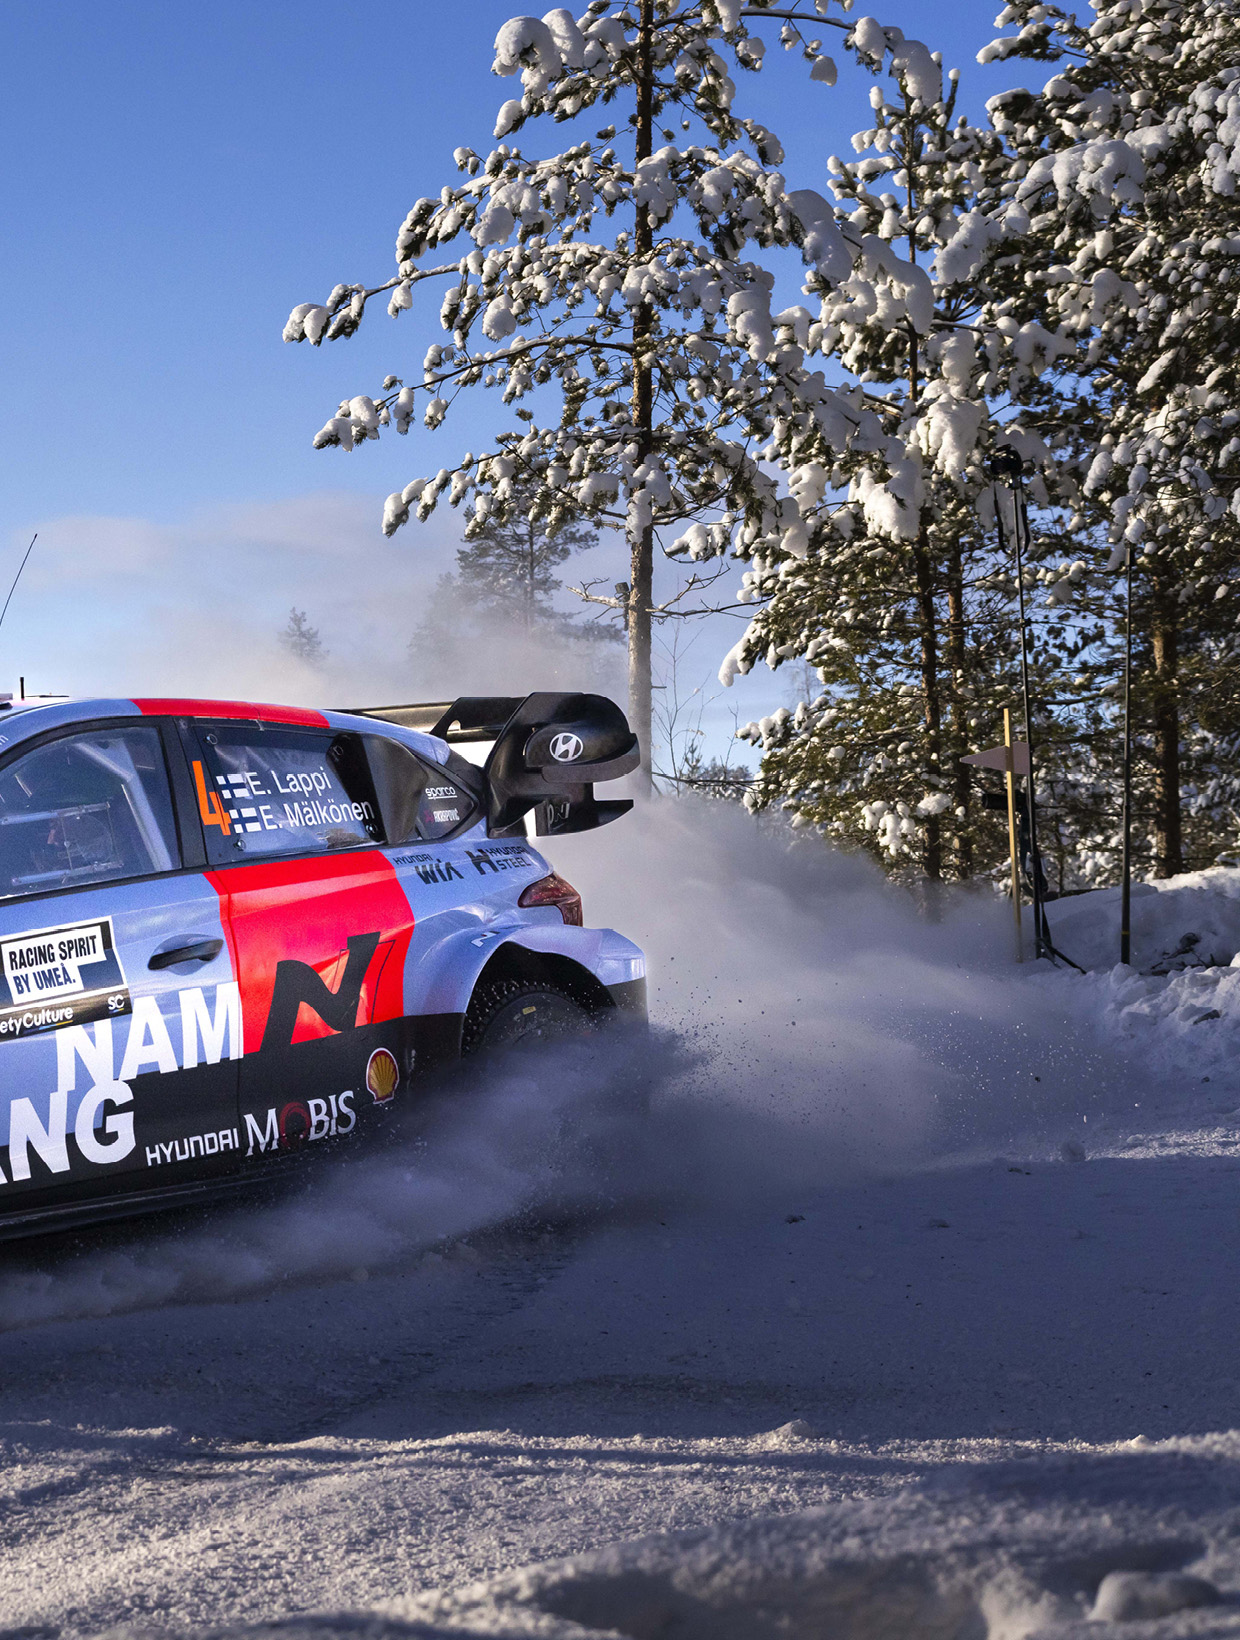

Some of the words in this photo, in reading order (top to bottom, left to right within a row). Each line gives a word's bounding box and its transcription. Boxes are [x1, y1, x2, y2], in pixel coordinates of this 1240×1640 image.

[192, 760, 231, 836] 4
[245, 771, 271, 795] E.
[271, 766, 332, 798] Lappi
[425, 786, 457, 800] sparco
[260, 804, 282, 831] E.
[283, 799, 375, 828] Mälkönen
[393, 853, 434, 865] HYUNDAI
[485, 846, 527, 857] HYUNDAI
[497, 856, 531, 870] STEEL
[8, 947, 55, 971] RACING
[58, 935, 98, 962] SPIRIT
[13, 973, 31, 995] BY
[35, 963, 76, 991] UMEÅ.
[107, 994, 125, 1012] SC
[55, 981, 244, 1092] NAM
[145, 1128, 240, 1166] HYUNDAI
[243, 1091, 357, 1157] MOBIS
